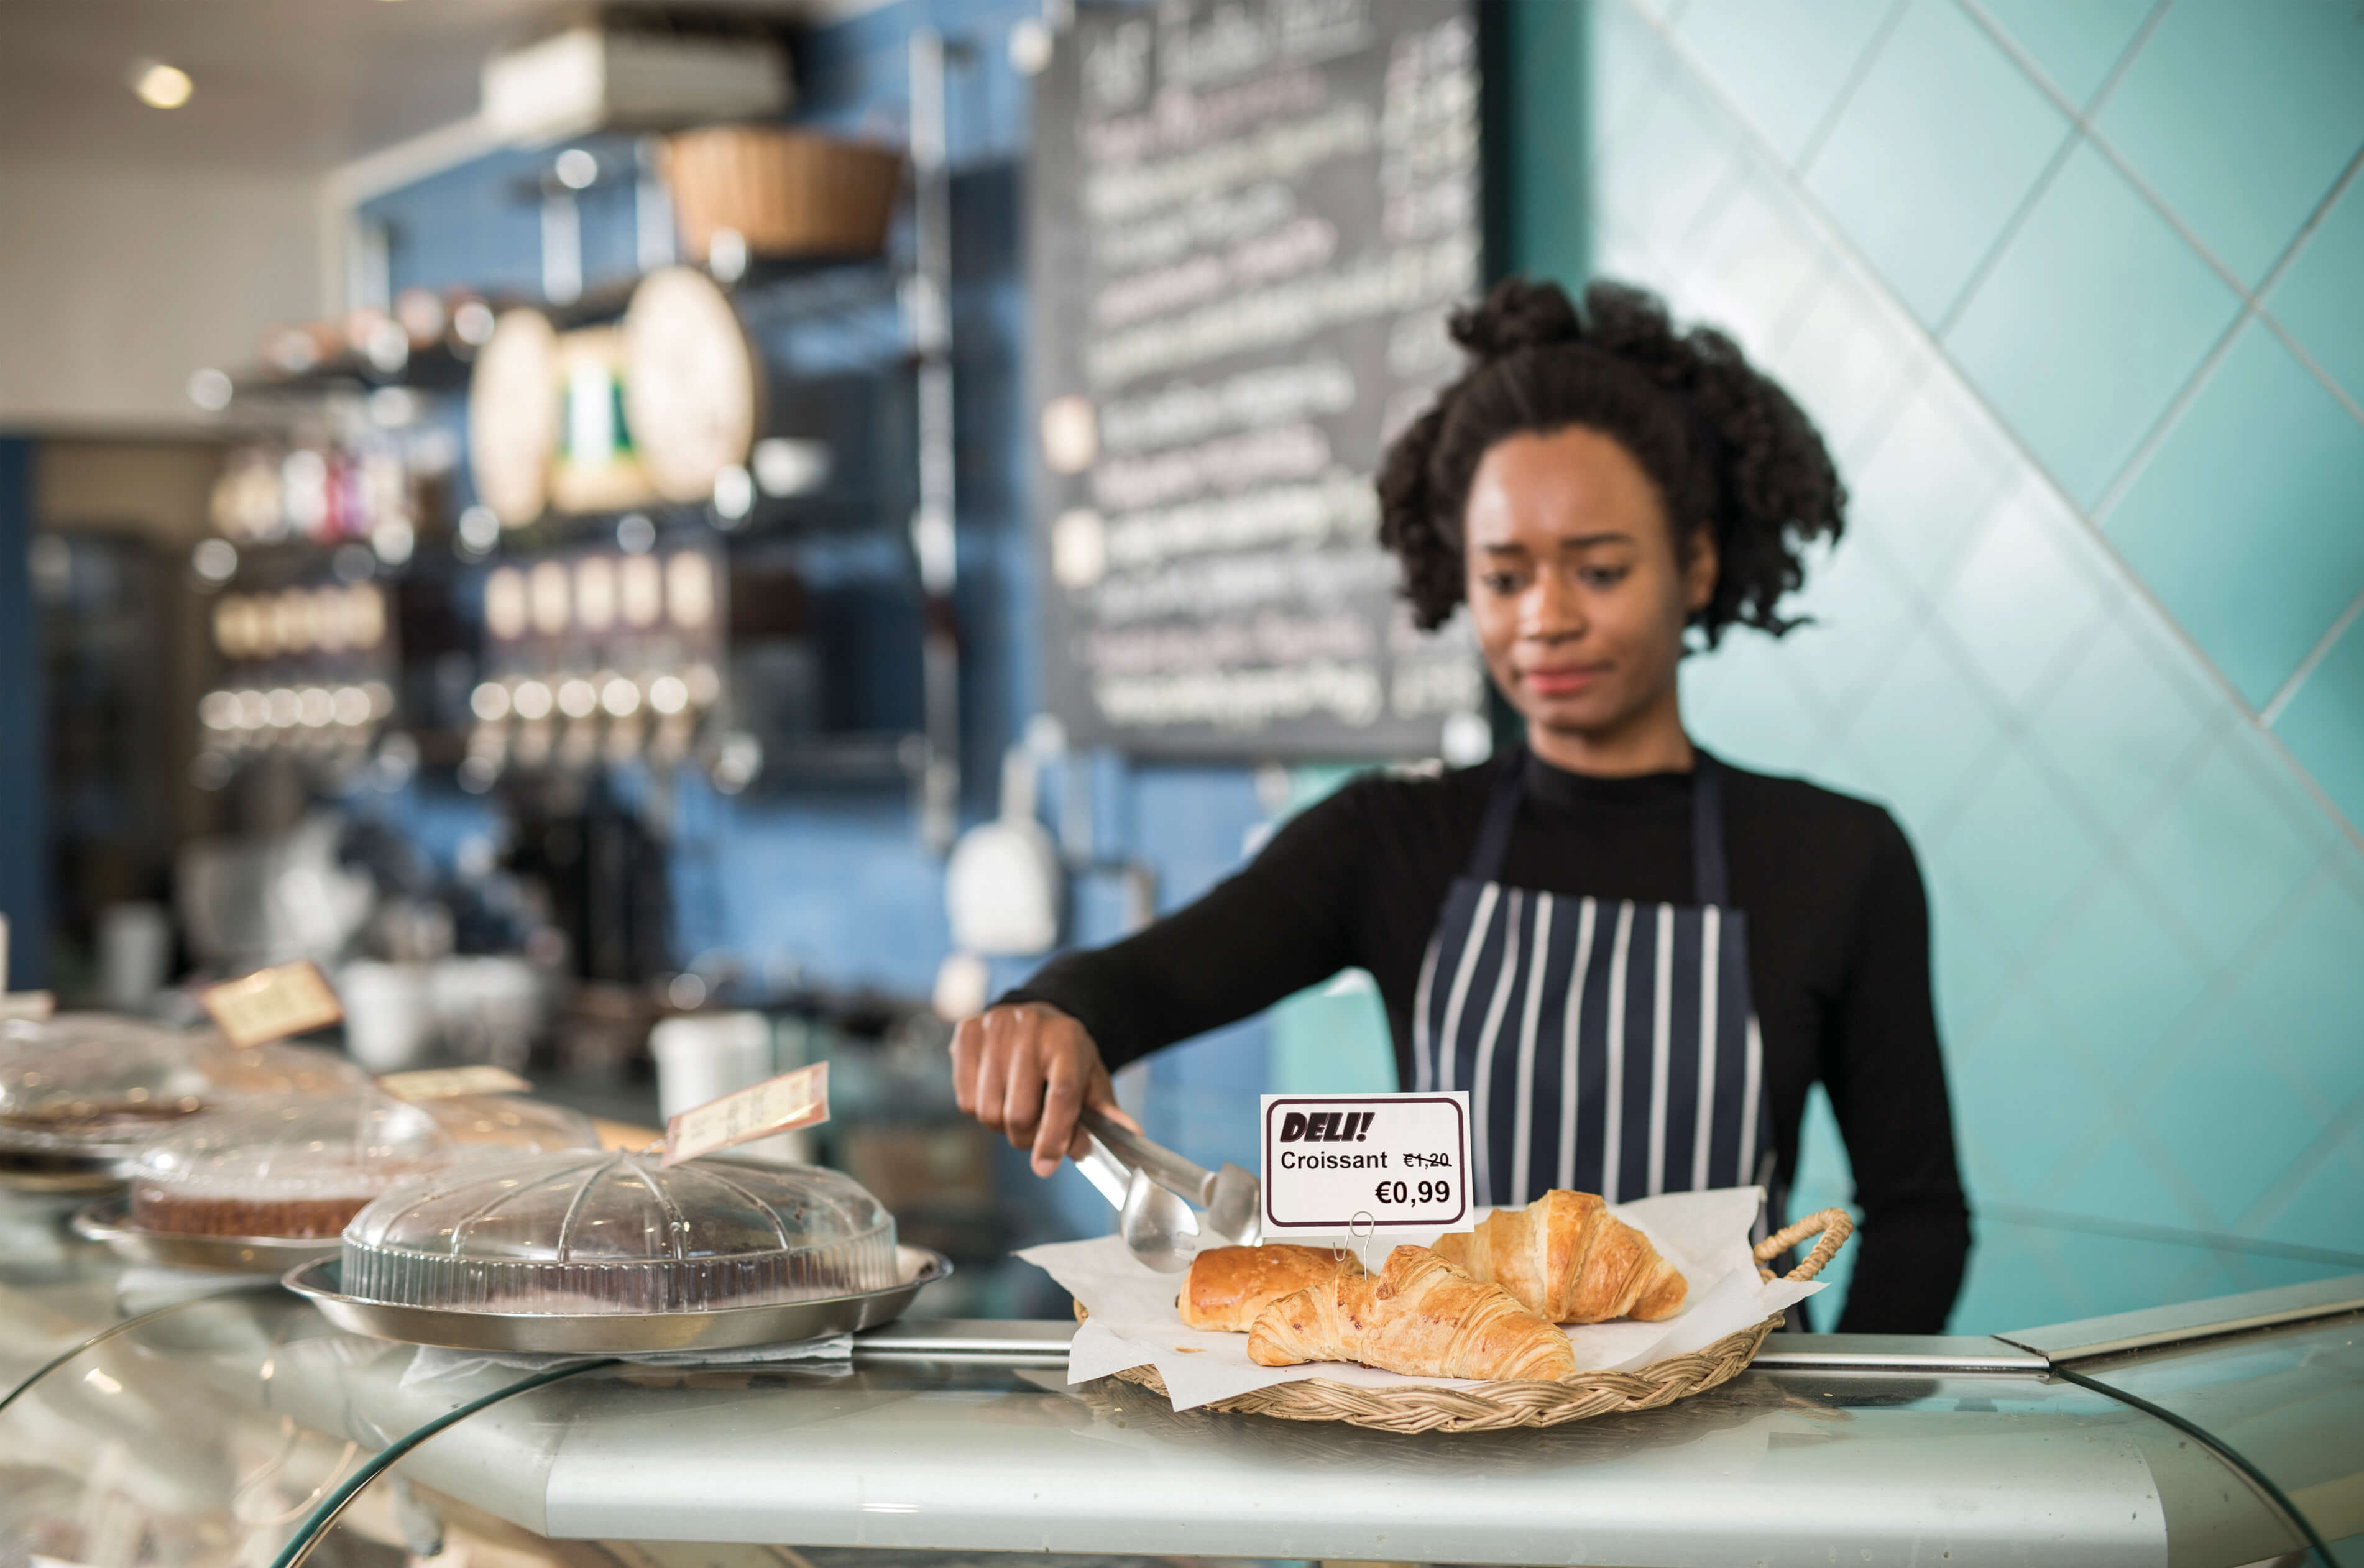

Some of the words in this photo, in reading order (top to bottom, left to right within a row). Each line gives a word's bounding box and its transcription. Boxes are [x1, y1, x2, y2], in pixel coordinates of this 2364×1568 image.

[1279, 1112, 1375, 1142] DELI!
[1281, 1151, 1387, 1169] Croissant
[1403, 1153, 1451, 1169] €1,20
[1375, 1181, 1450, 1207] €0,99
